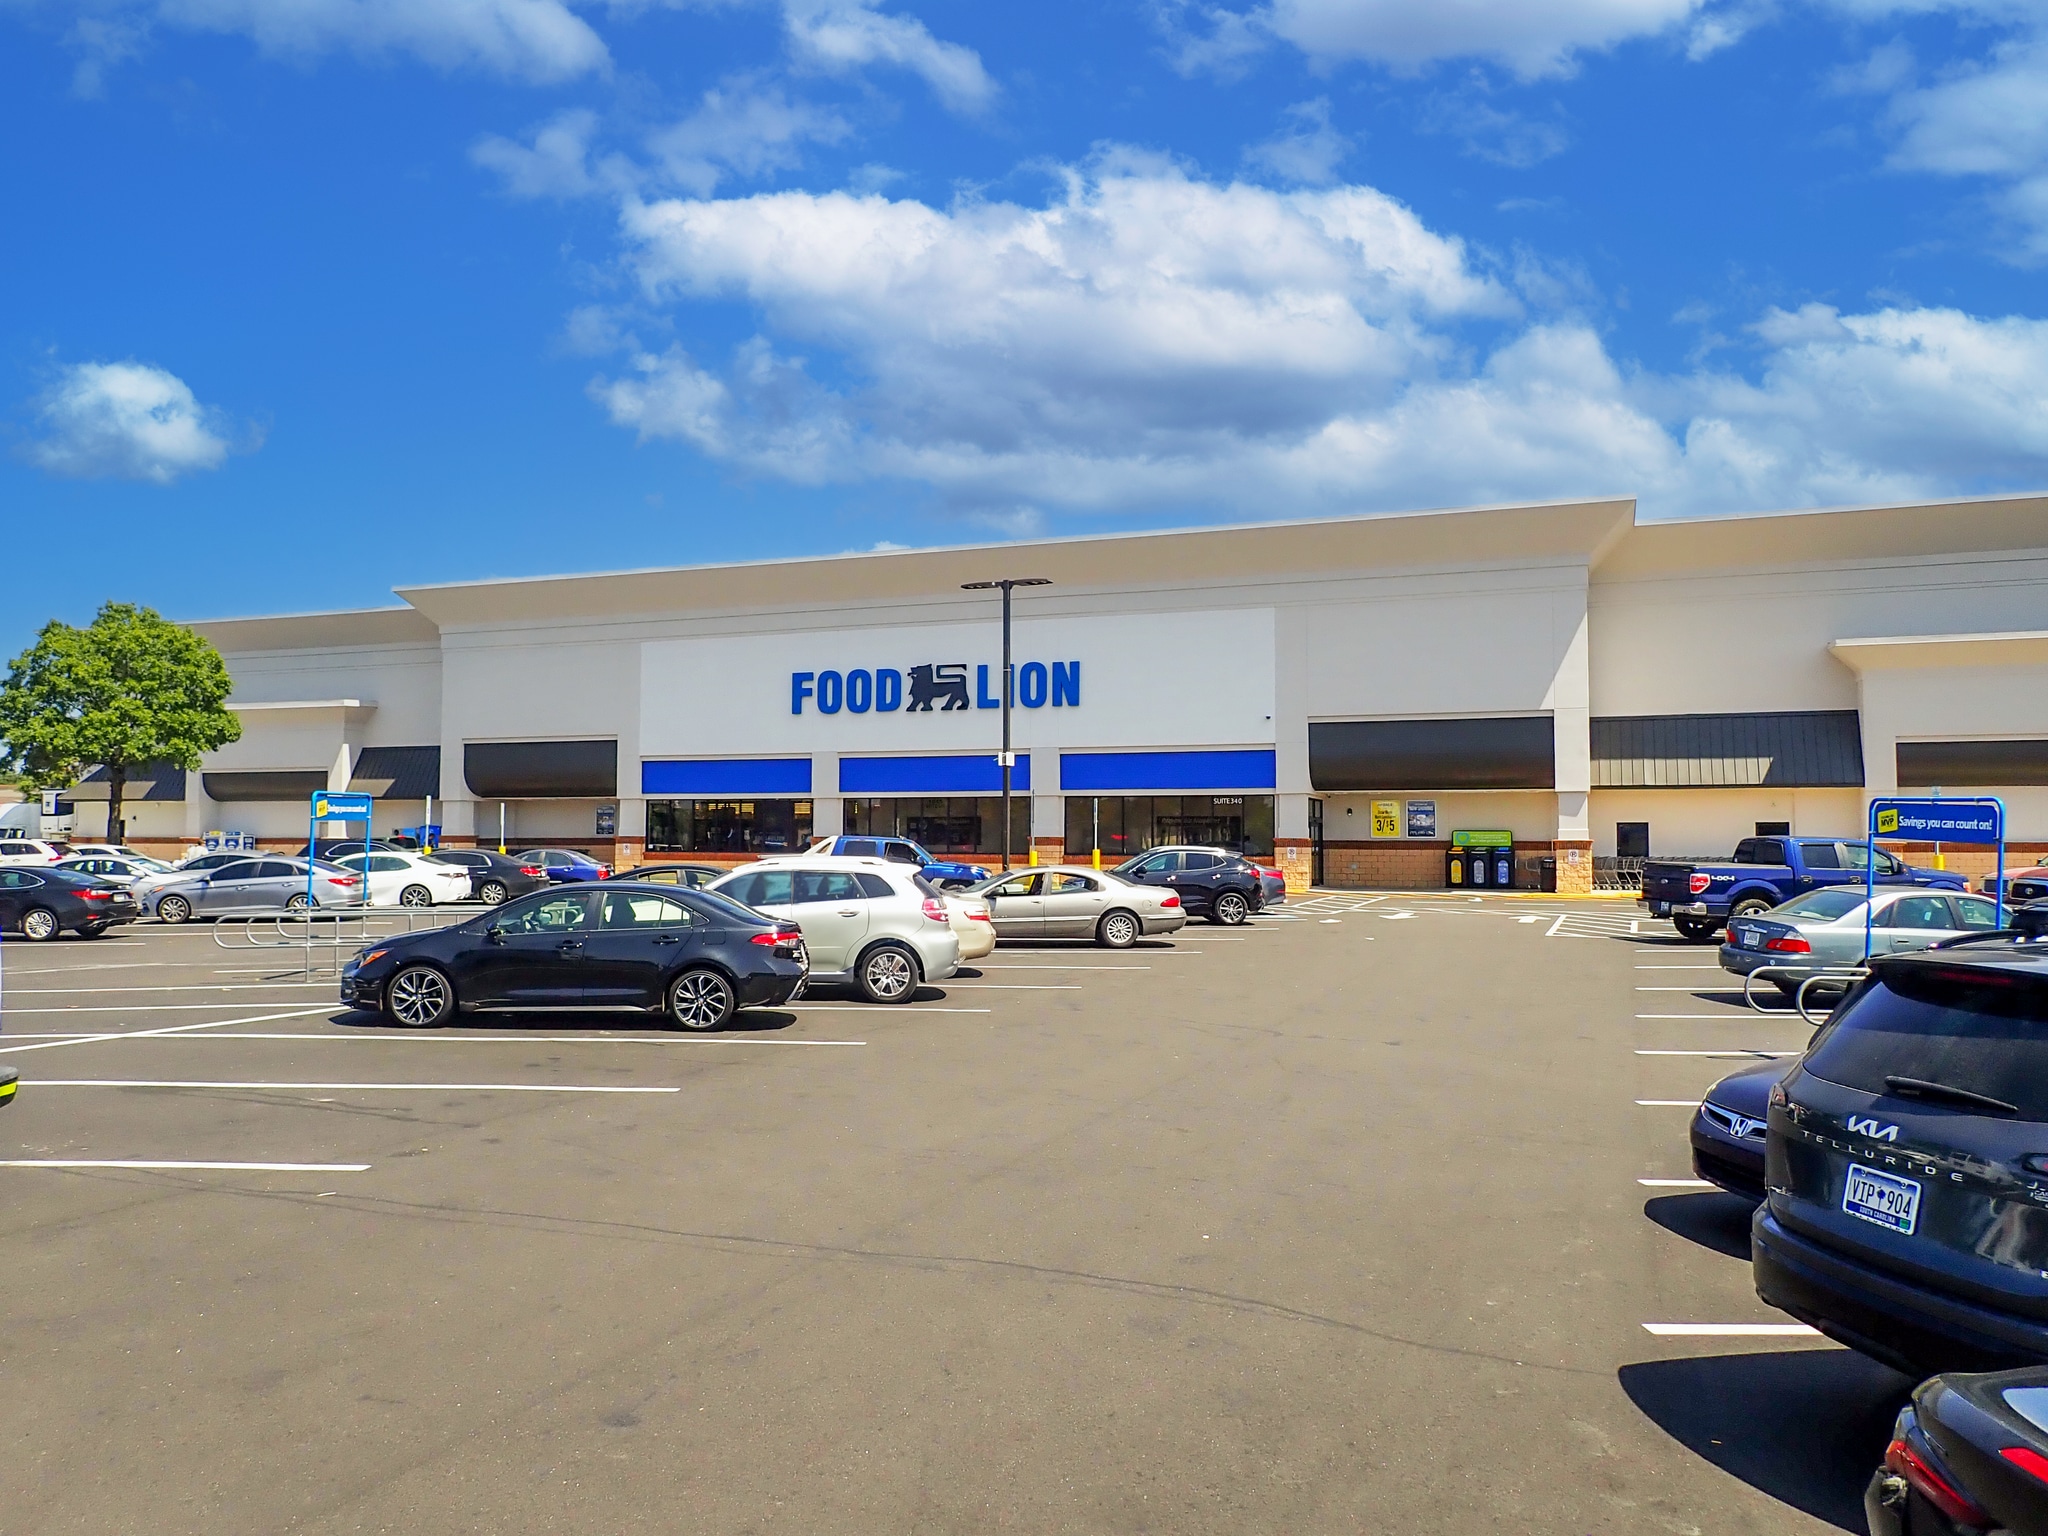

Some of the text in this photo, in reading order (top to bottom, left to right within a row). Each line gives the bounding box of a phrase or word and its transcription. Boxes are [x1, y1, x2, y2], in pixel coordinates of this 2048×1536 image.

[792, 669, 901, 714] FOOD
[1881, 817, 1894, 827] MVP
[1898, 816, 1993, 830] Savings you can count on!
[1847, 1115, 1900, 1142] KIA
[1802, 1130, 1964, 1182] TELLURIDE
[1853, 1178, 1912, 1218] VIP 904
[1860, 1206, 1873, 1216] SOUTH
[1874, 1209, 1896, 1223] CAROLINA
